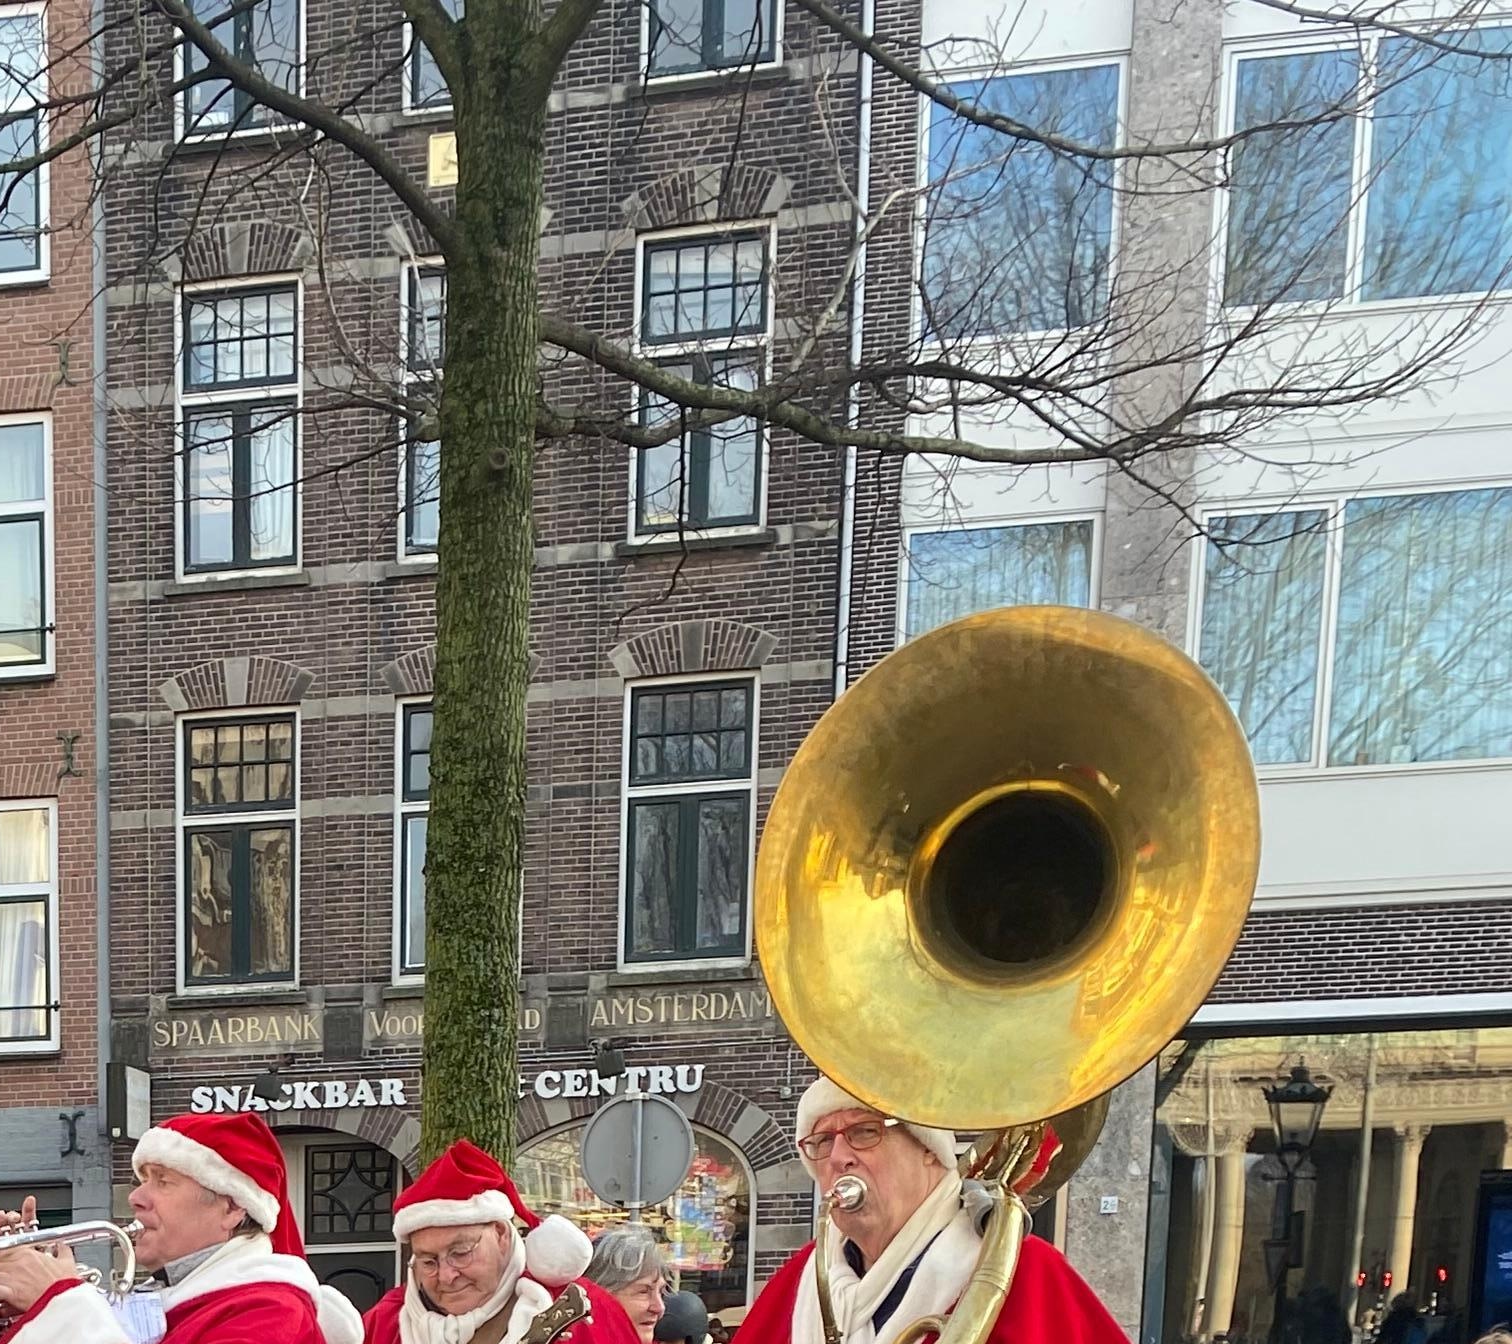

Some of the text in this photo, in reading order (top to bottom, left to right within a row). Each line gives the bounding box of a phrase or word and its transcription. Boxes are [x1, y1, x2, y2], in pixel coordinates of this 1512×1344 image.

[152, 1013, 322, 1047] SPAARBANK
[590, 991, 774, 1027] AMSTERDAM
[190, 1078, 408, 1114] SNACKBAR
[535, 1064, 706, 1099] CENTRU
